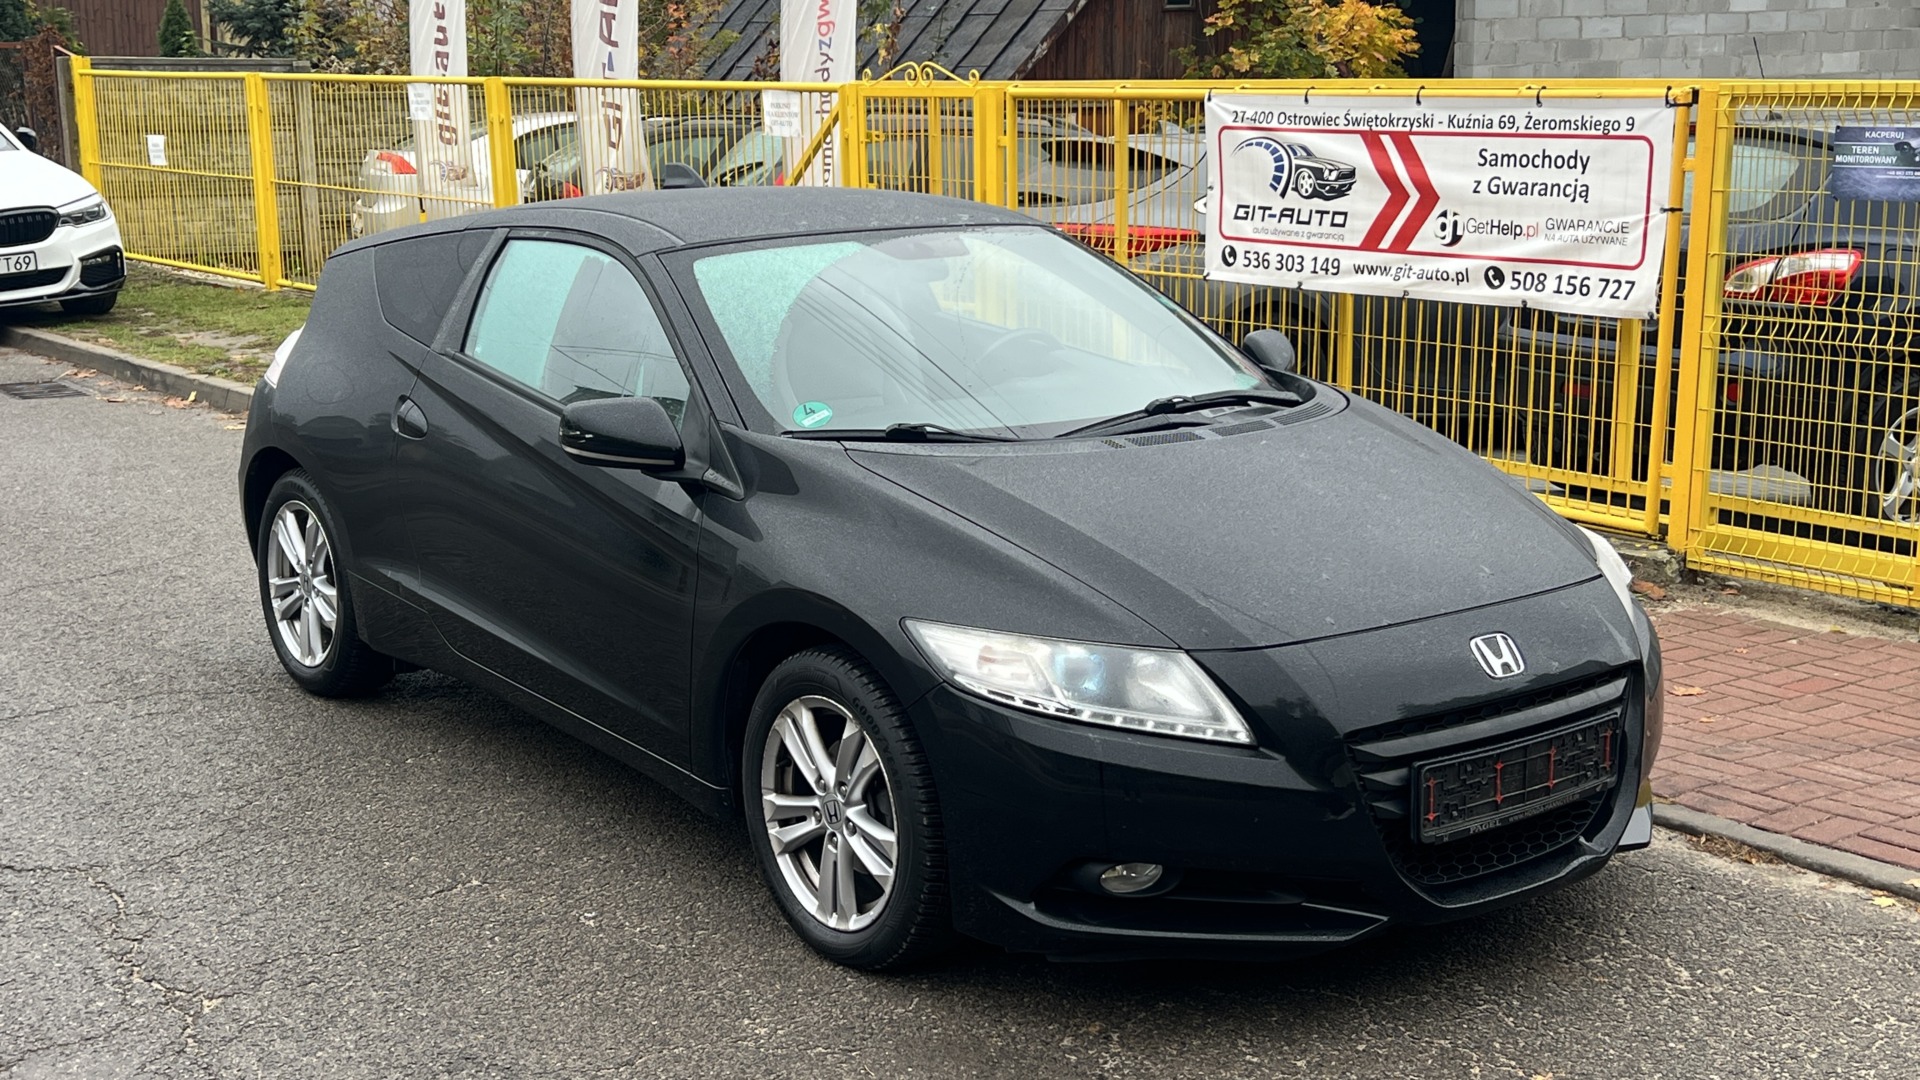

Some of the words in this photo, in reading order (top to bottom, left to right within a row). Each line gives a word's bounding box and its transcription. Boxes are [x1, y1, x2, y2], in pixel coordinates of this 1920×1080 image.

[433, 1, 458, 147] gitaut
[599, 0, 623, 151] GIT-A
[1231, 110, 1274, 125] 27-400
[1277, 111, 1340, 127] Ostrowiec
[1343, 109, 1434, 132] Świętokrzyski
[1447, 113, 1494, 130] Kuźnia
[1498, 114, 1520, 132] 69,
[1524, 111, 1621, 135] Żeromskiego
[1625, 116, 1635, 132] 9
[1865, 131, 1905, 140] KACPERUJ
[1477, 148, 1591, 175] Samochody
[1835, 154, 1898, 164] MONITOROWANY
[1851, 145, 1880, 154] TEREN
[1472, 179, 1482, 194] z
[1487, 176, 1590, 203] Gwarancją
[1233, 204, 1349, 228] GIT-AUTO
[1545, 217, 1630, 234] GWARANCJE
[1252, 226, 1269, 236] auta
[1270, 227, 1300, 239] używane
[1306, 230, 1345, 243] gwarancją
[1466, 217, 1539, 240] GetHelp.pl
[1544, 233, 1556, 242] NA
[1557, 234, 1579, 243] AUTA
[1581, 234, 1628, 246] UŻYWANE
[0, 255, 31, 272] T69
[1242, 250, 1271, 270] 536
[1274, 253, 1305, 273] 303
[1309, 256, 1341, 276] 149
[1353, 262, 1470, 286] www.git-auto.pl
[1510, 270, 1547, 293] 508
[1552, 274, 1591, 297] 156
[1598, 277, 1636, 301] 727
